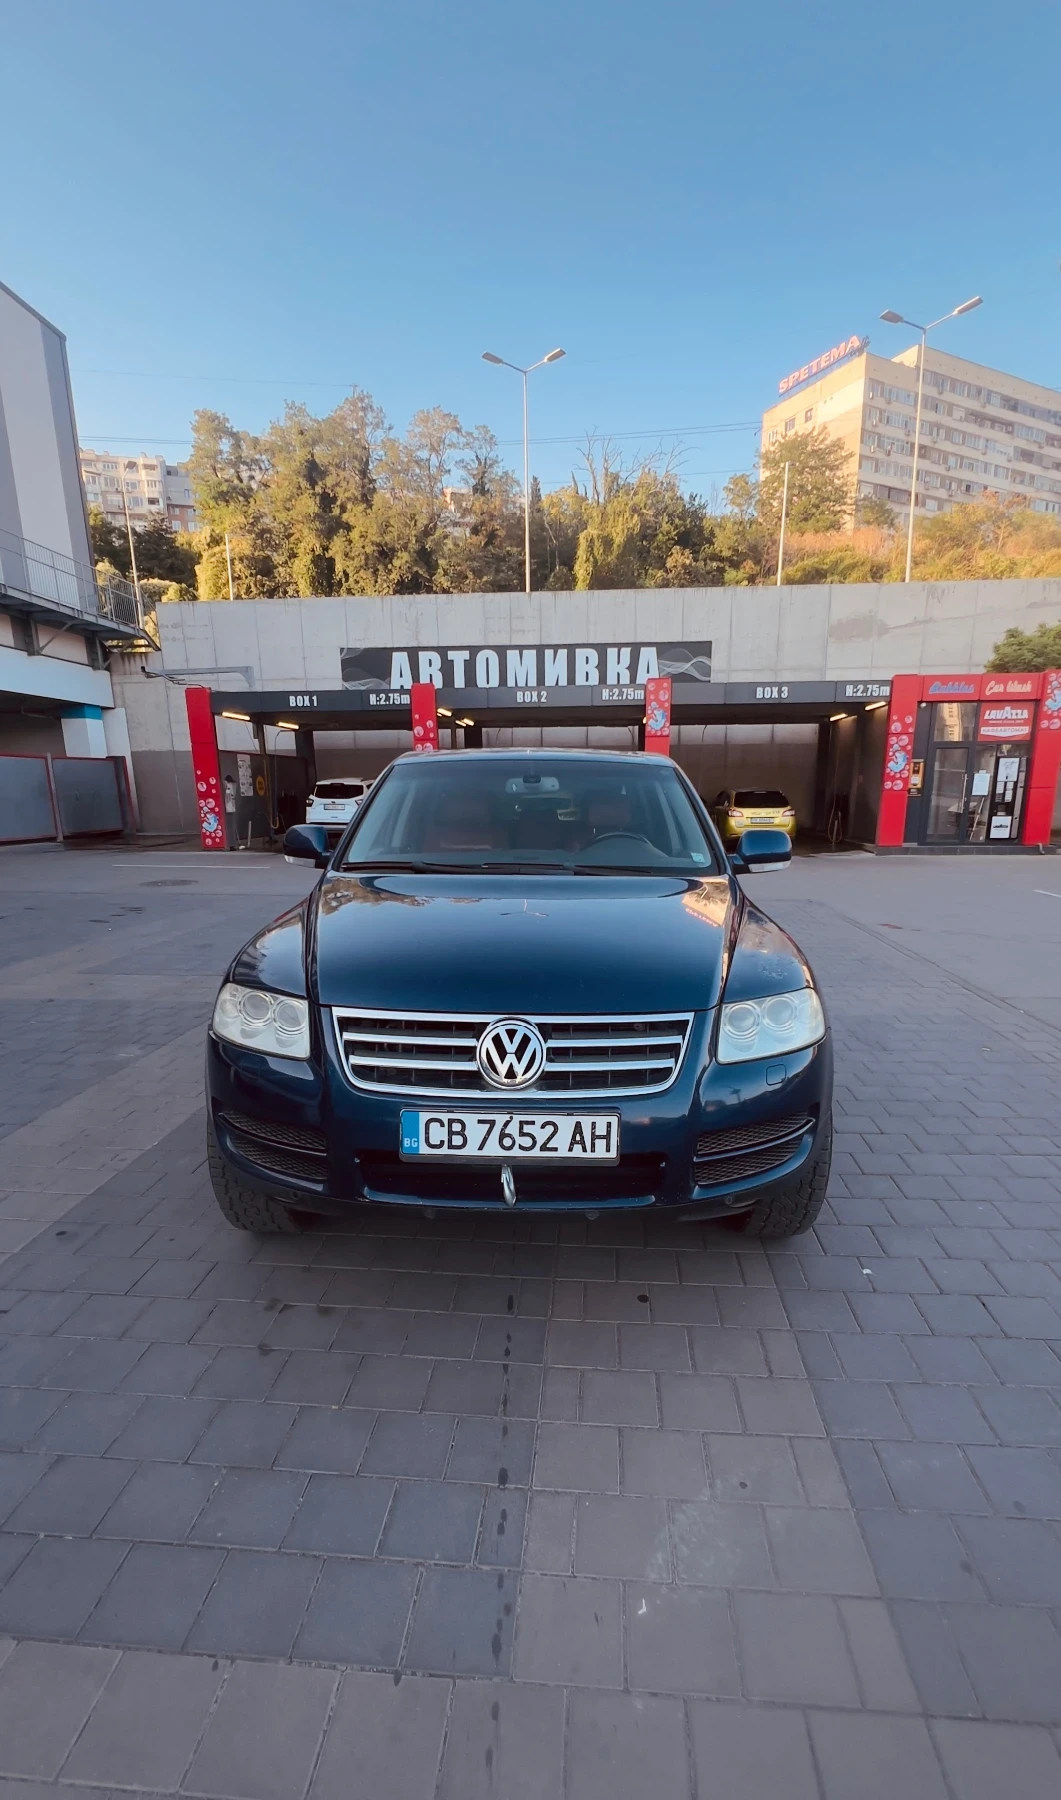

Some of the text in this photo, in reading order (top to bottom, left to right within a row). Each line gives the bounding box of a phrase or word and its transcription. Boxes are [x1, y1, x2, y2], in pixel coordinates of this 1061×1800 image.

[778, 335, 860, 394] SPETEMA
[390, 646, 661, 690] АВТОМИВКА
[602, 688, 645, 701] H:2.75m
[756, 686, 789, 699] BOX 3
[845, 684, 890, 697] H:2.75m
[985, 680, 1033, 696] Car Wash
[289, 695, 318, 707] BOX 1
[369, 693, 411, 706] H:2.75m
[516, 691, 547, 703] BOX 2
[983, 705, 1028, 720] LAVAZZA
[424, 1117, 612, 1153] CB 7652 AH
[403, 1138, 418, 1148] BG
